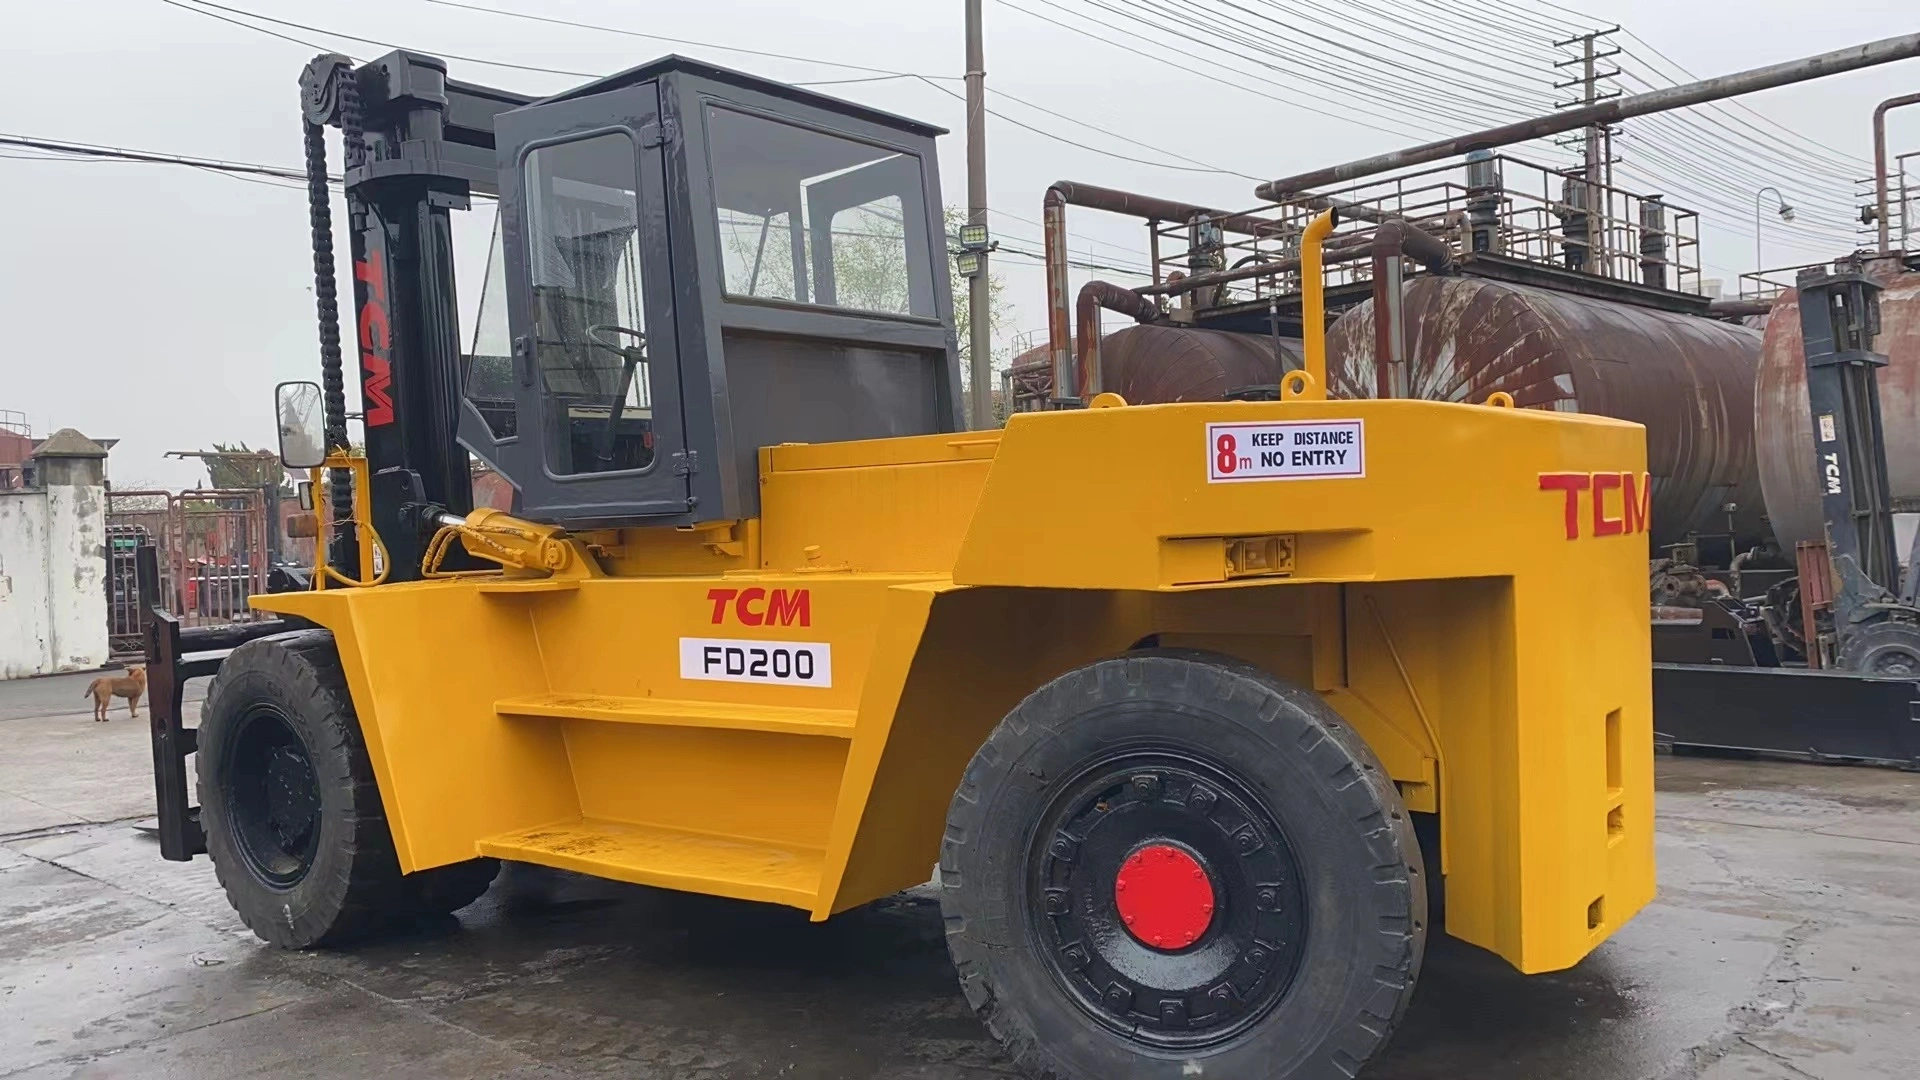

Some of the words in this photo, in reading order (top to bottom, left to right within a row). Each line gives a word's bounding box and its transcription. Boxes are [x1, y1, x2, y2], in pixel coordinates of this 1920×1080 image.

[355, 250, 394, 427] TCM
[1252, 433, 1284, 447] KEEP
[1294, 431, 1353, 446] DISTANCE
[1261, 451, 1285, 467] NO
[1292, 449, 1348, 467] ENTRY
[1824, 452, 1841, 494] TCM
[1538, 472, 1651, 541] TCM
[707, 587, 811, 627] TCM
[703, 646, 814, 680] FD200
